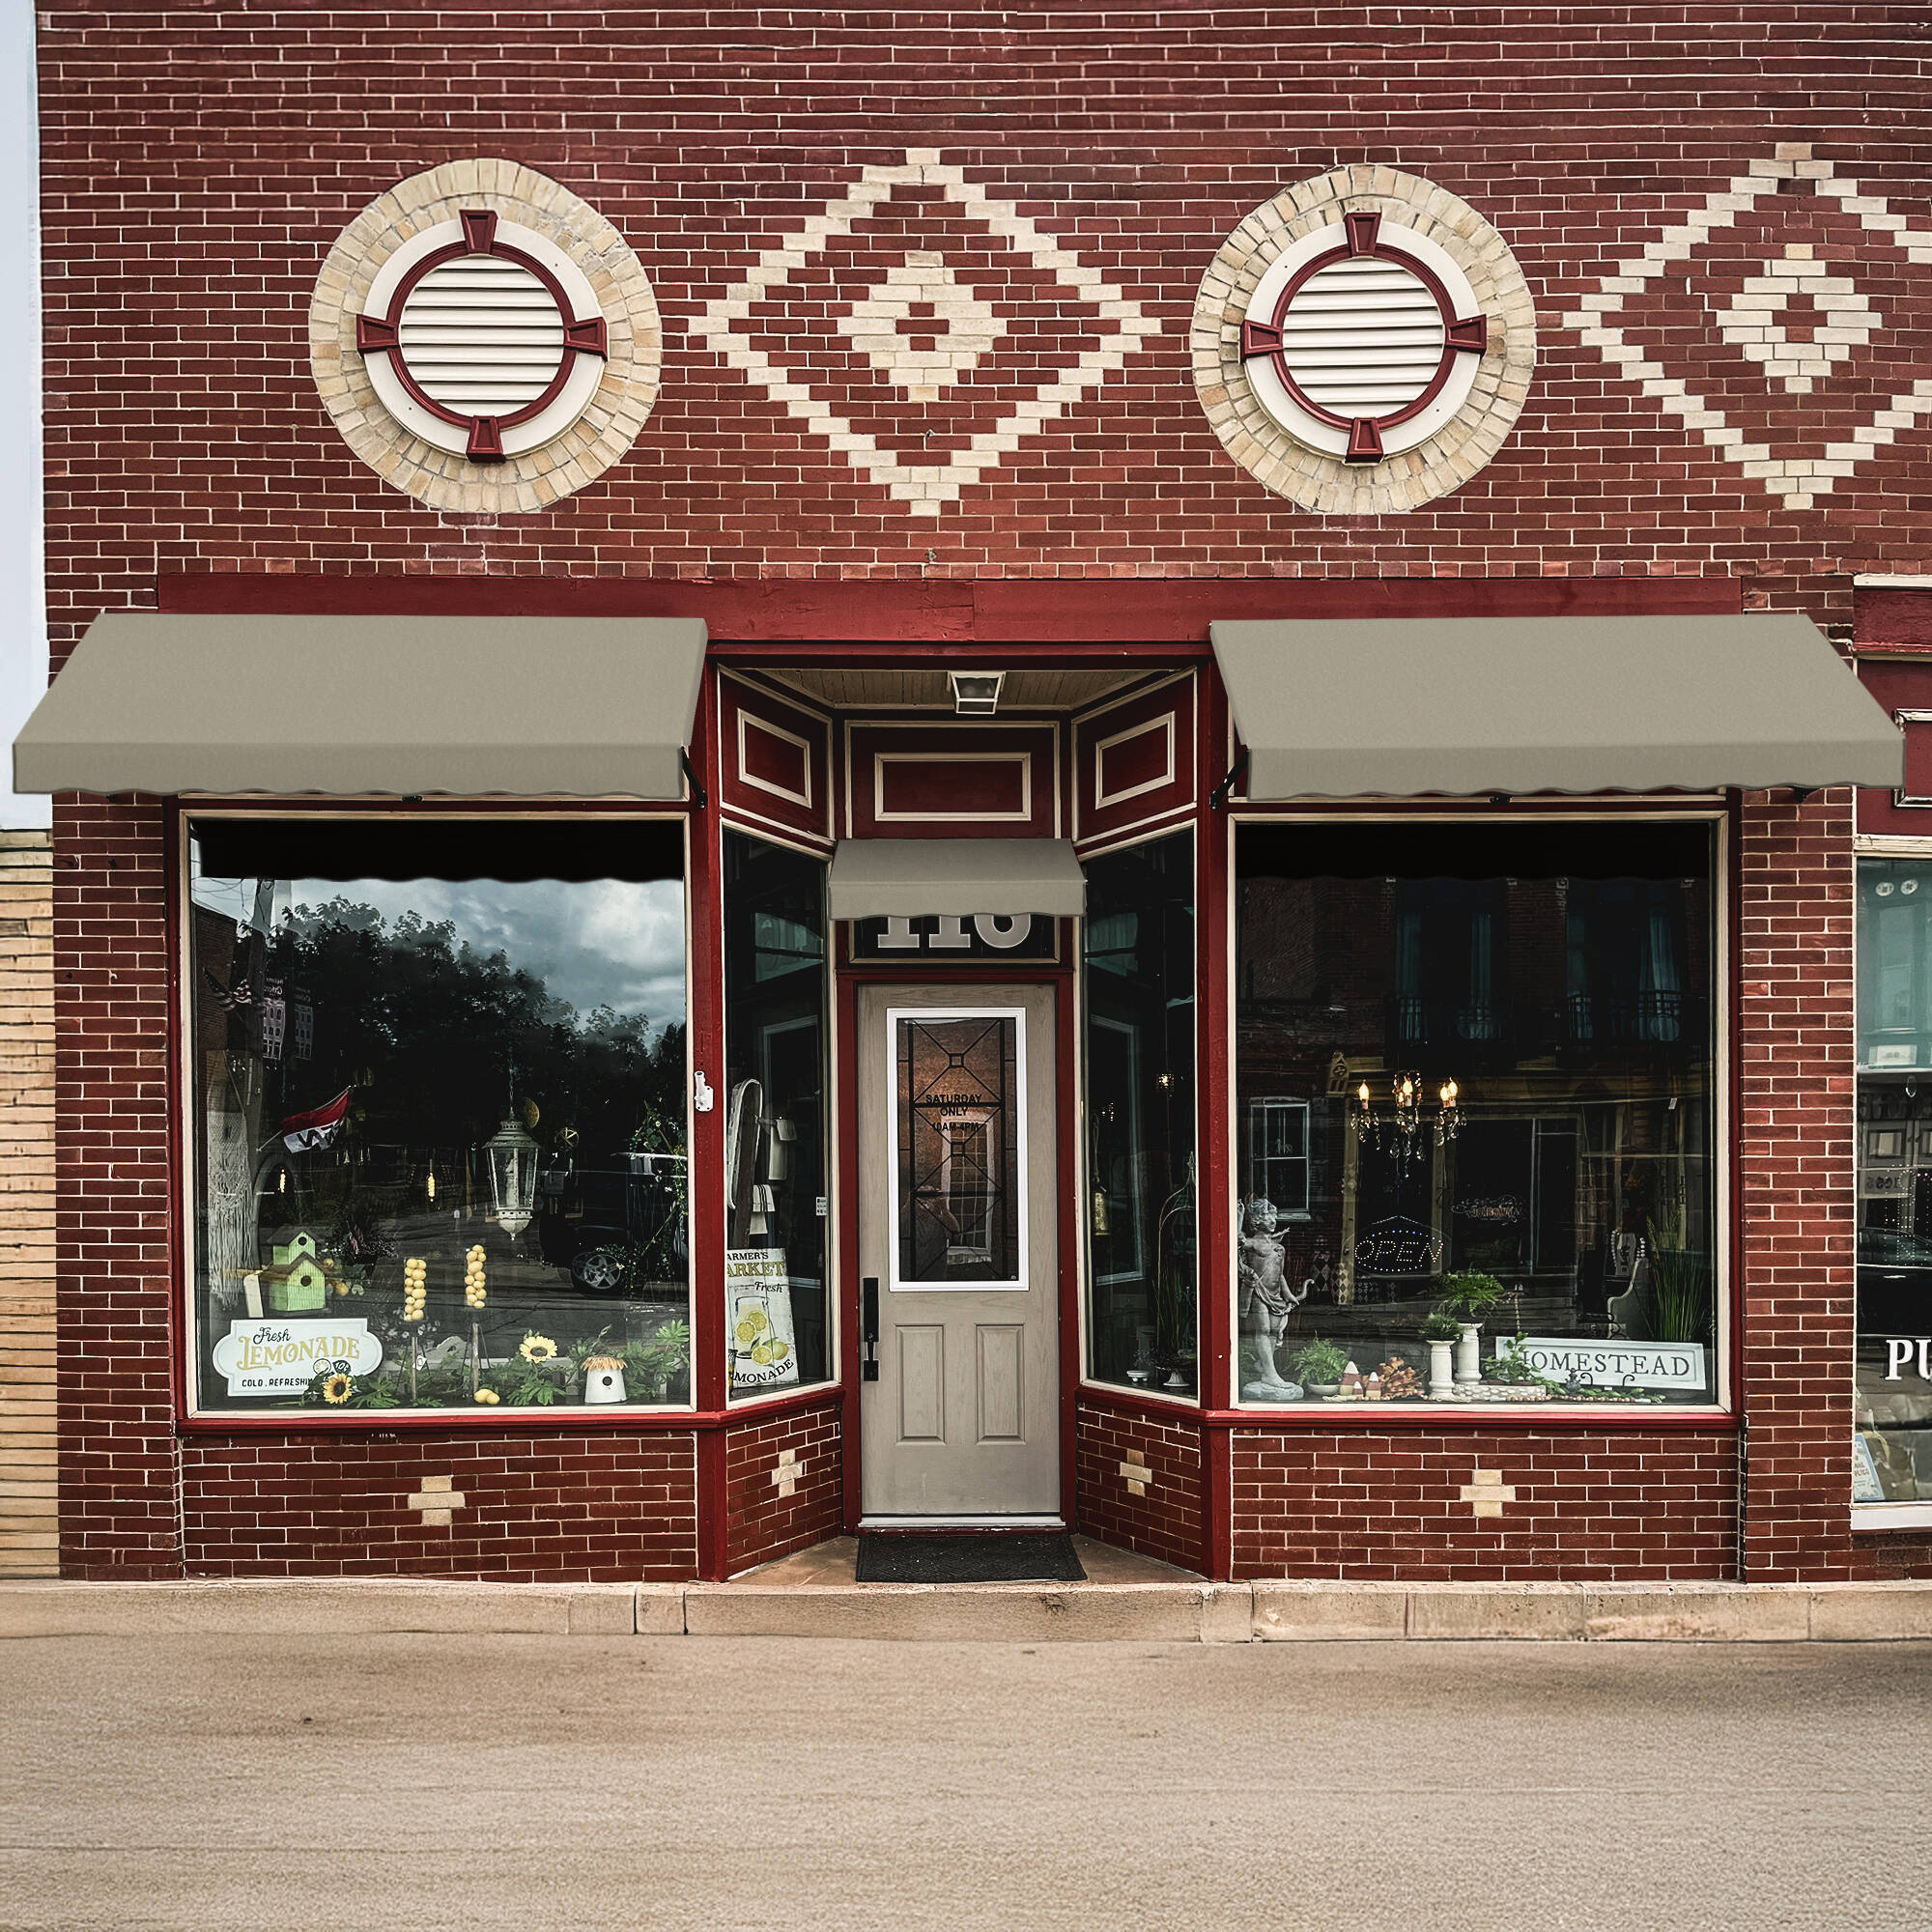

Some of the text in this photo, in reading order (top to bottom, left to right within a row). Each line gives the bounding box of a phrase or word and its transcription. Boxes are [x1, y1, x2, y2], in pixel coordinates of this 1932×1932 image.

[925, 1094, 982, 1102] SATURDAY
[940, 1106, 969, 1117] ONLY
[726, 1252, 770, 1261] ARMER'S
[1354, 1240, 1444, 1263] OPEN
[726, 1262, 784, 1277] ARKET
[754, 1281, 782, 1293] Fresh
[253, 1326, 292, 1345] Fresh
[237, 1336, 360, 1371] LEMONADE
[732, 1358, 794, 1382] MONADE
[269, 1378, 313, 1387] REFRESHIN
